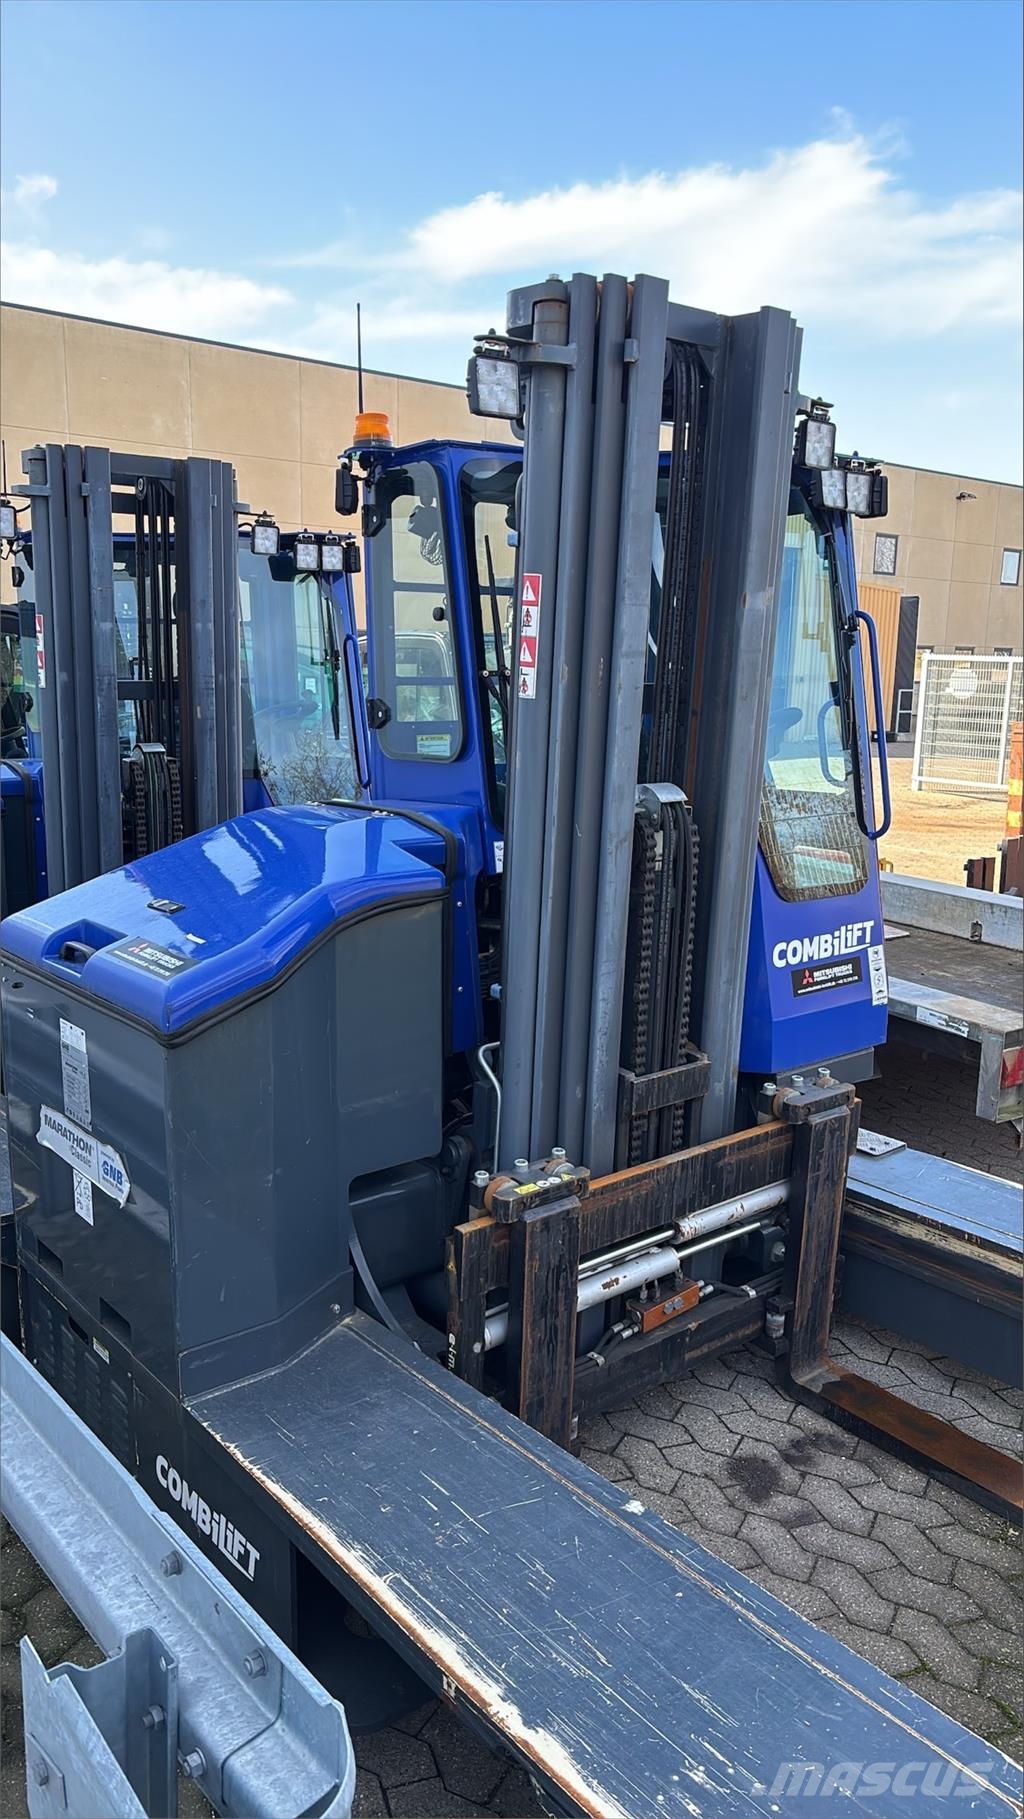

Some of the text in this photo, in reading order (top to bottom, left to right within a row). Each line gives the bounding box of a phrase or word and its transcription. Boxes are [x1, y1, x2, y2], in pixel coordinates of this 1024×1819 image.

[813, 963, 853, 978] MITSUBISHI
[44, 1113, 92, 1157] MARATHON
[101, 1160, 123, 1186] GNB
